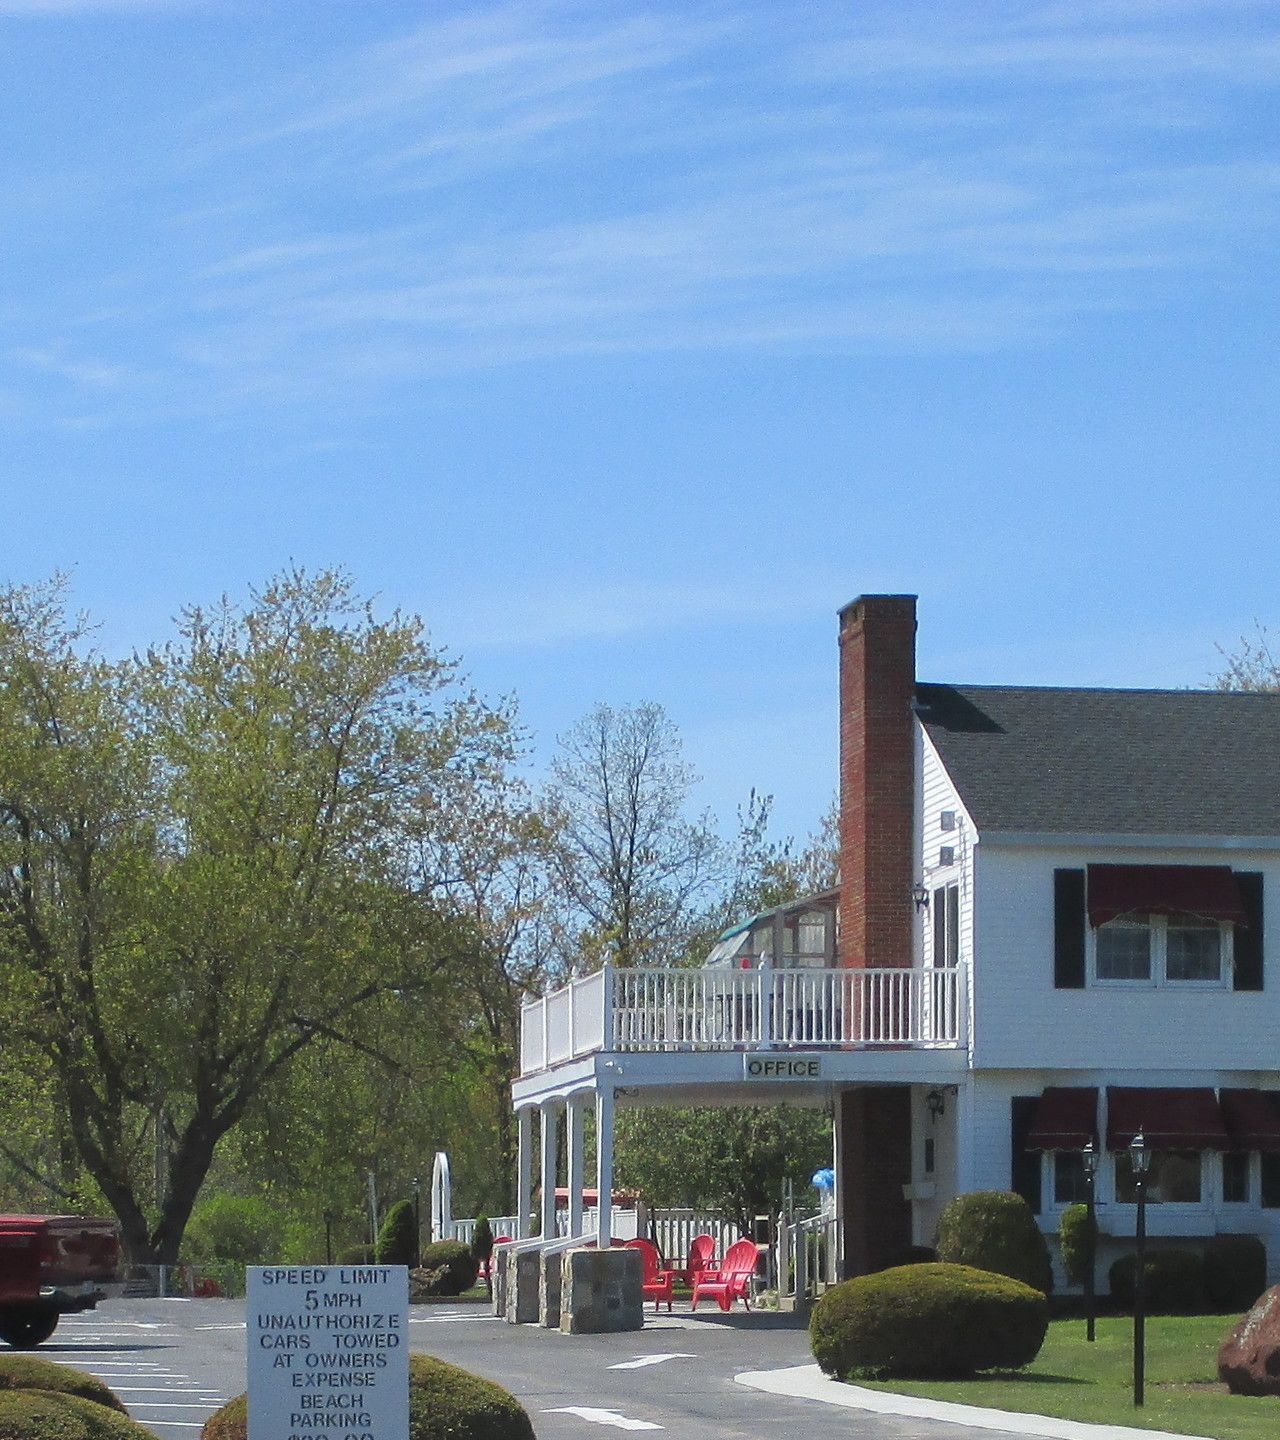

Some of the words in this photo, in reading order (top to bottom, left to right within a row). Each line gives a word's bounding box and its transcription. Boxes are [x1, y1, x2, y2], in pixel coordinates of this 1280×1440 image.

[749, 1061, 818, 1076] OFFICE
[262, 1270, 325, 1285] SPEED
[340, 1270, 390, 1284] LIMIT
[306, 1290, 318, 1311] 5
[323, 1294, 361, 1308] MPH
[258, 1315, 399, 1330] UNAUTHORIZE
[260, 1334, 310, 1350] CARS
[332, 1334, 399, 1348] TOWED
[273, 1354, 294, 1369] AT
[306, 1354, 387, 1368] OWNERS
[292, 1373, 376, 1387] EXPENSE
[301, 1394, 363, 1409] BEACH
[290, 1413, 371, 1428] PARKING
